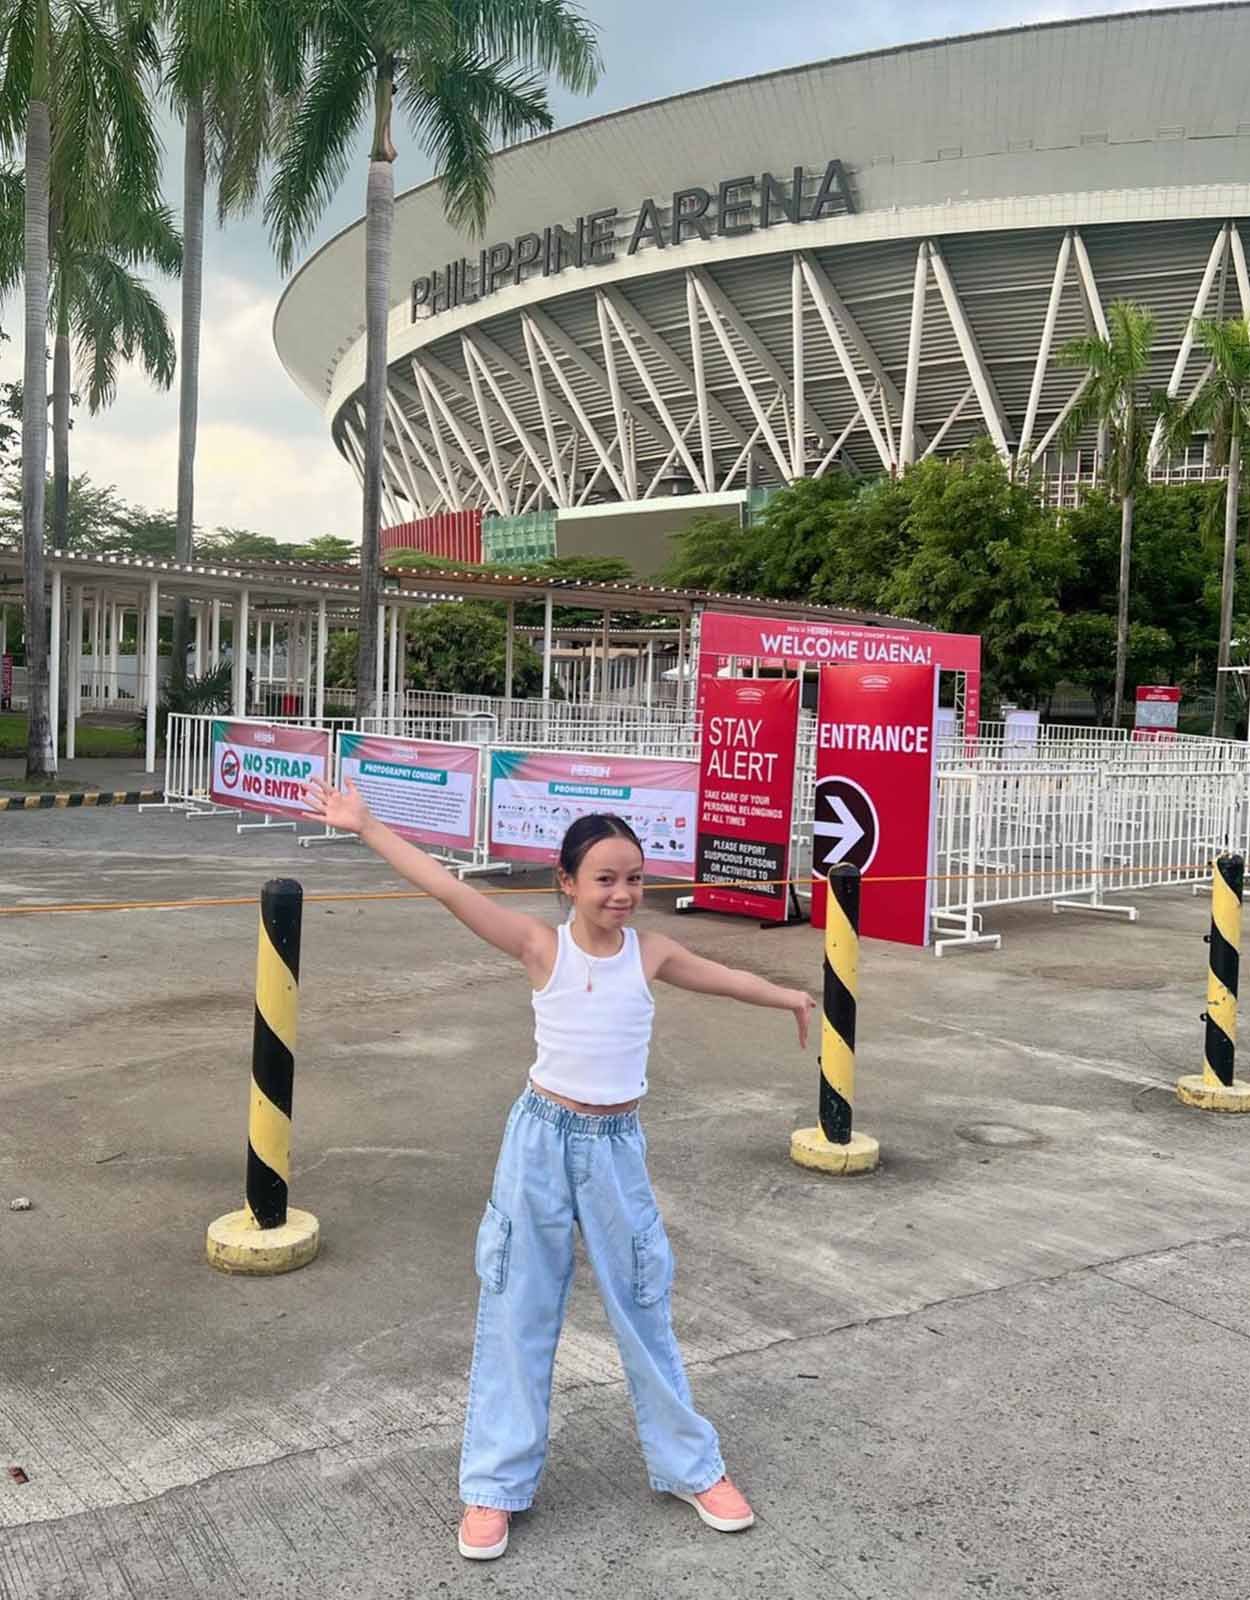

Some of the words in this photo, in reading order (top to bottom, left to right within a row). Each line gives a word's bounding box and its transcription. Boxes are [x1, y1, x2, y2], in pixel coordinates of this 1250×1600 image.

[411, 206, 618, 324] PHILIPPINE
[626, 158, 856, 255] ARENA
[760, 633, 857, 659] WELCOME
[863, 642, 932, 664] UAENA!
[709, 716, 762, 748] STAY
[820, 723, 929, 753] ENTRANCE
[243, 753, 262, 772] NO
[265, 757, 312, 779] STRAP
[364, 763, 411, 778] PHOTOGRAPHY
[706, 749, 778, 783] ALERT
[242, 774, 262, 794] NO
[554, 784, 599, 795] PROHIBITED
[600, 787, 624, 797] ITEMS
[704, 790, 720, 800] TAKE
[721, 791, 738, 802] CARE
[740, 793, 749, 803] OF
[751, 795, 770, 805] YOUR
[702, 812, 710, 822] AT
[712, 813, 724, 824] ALL
[725, 815, 746, 827] TIMES
[703, 801, 737, 814] PERSONAL
[739, 805, 783, 819] BELONGINGS
[713, 840, 738, 852] PLEASE
[739, 843, 767, 856] REPORT
[704, 850, 743, 864] SUSPICIOUS
[744, 856, 776, 870] PERSONS
[711, 862, 720, 872] OR
[722, 865, 756, 878] ACTIVITIES
[758, 871, 768, 880] TO
